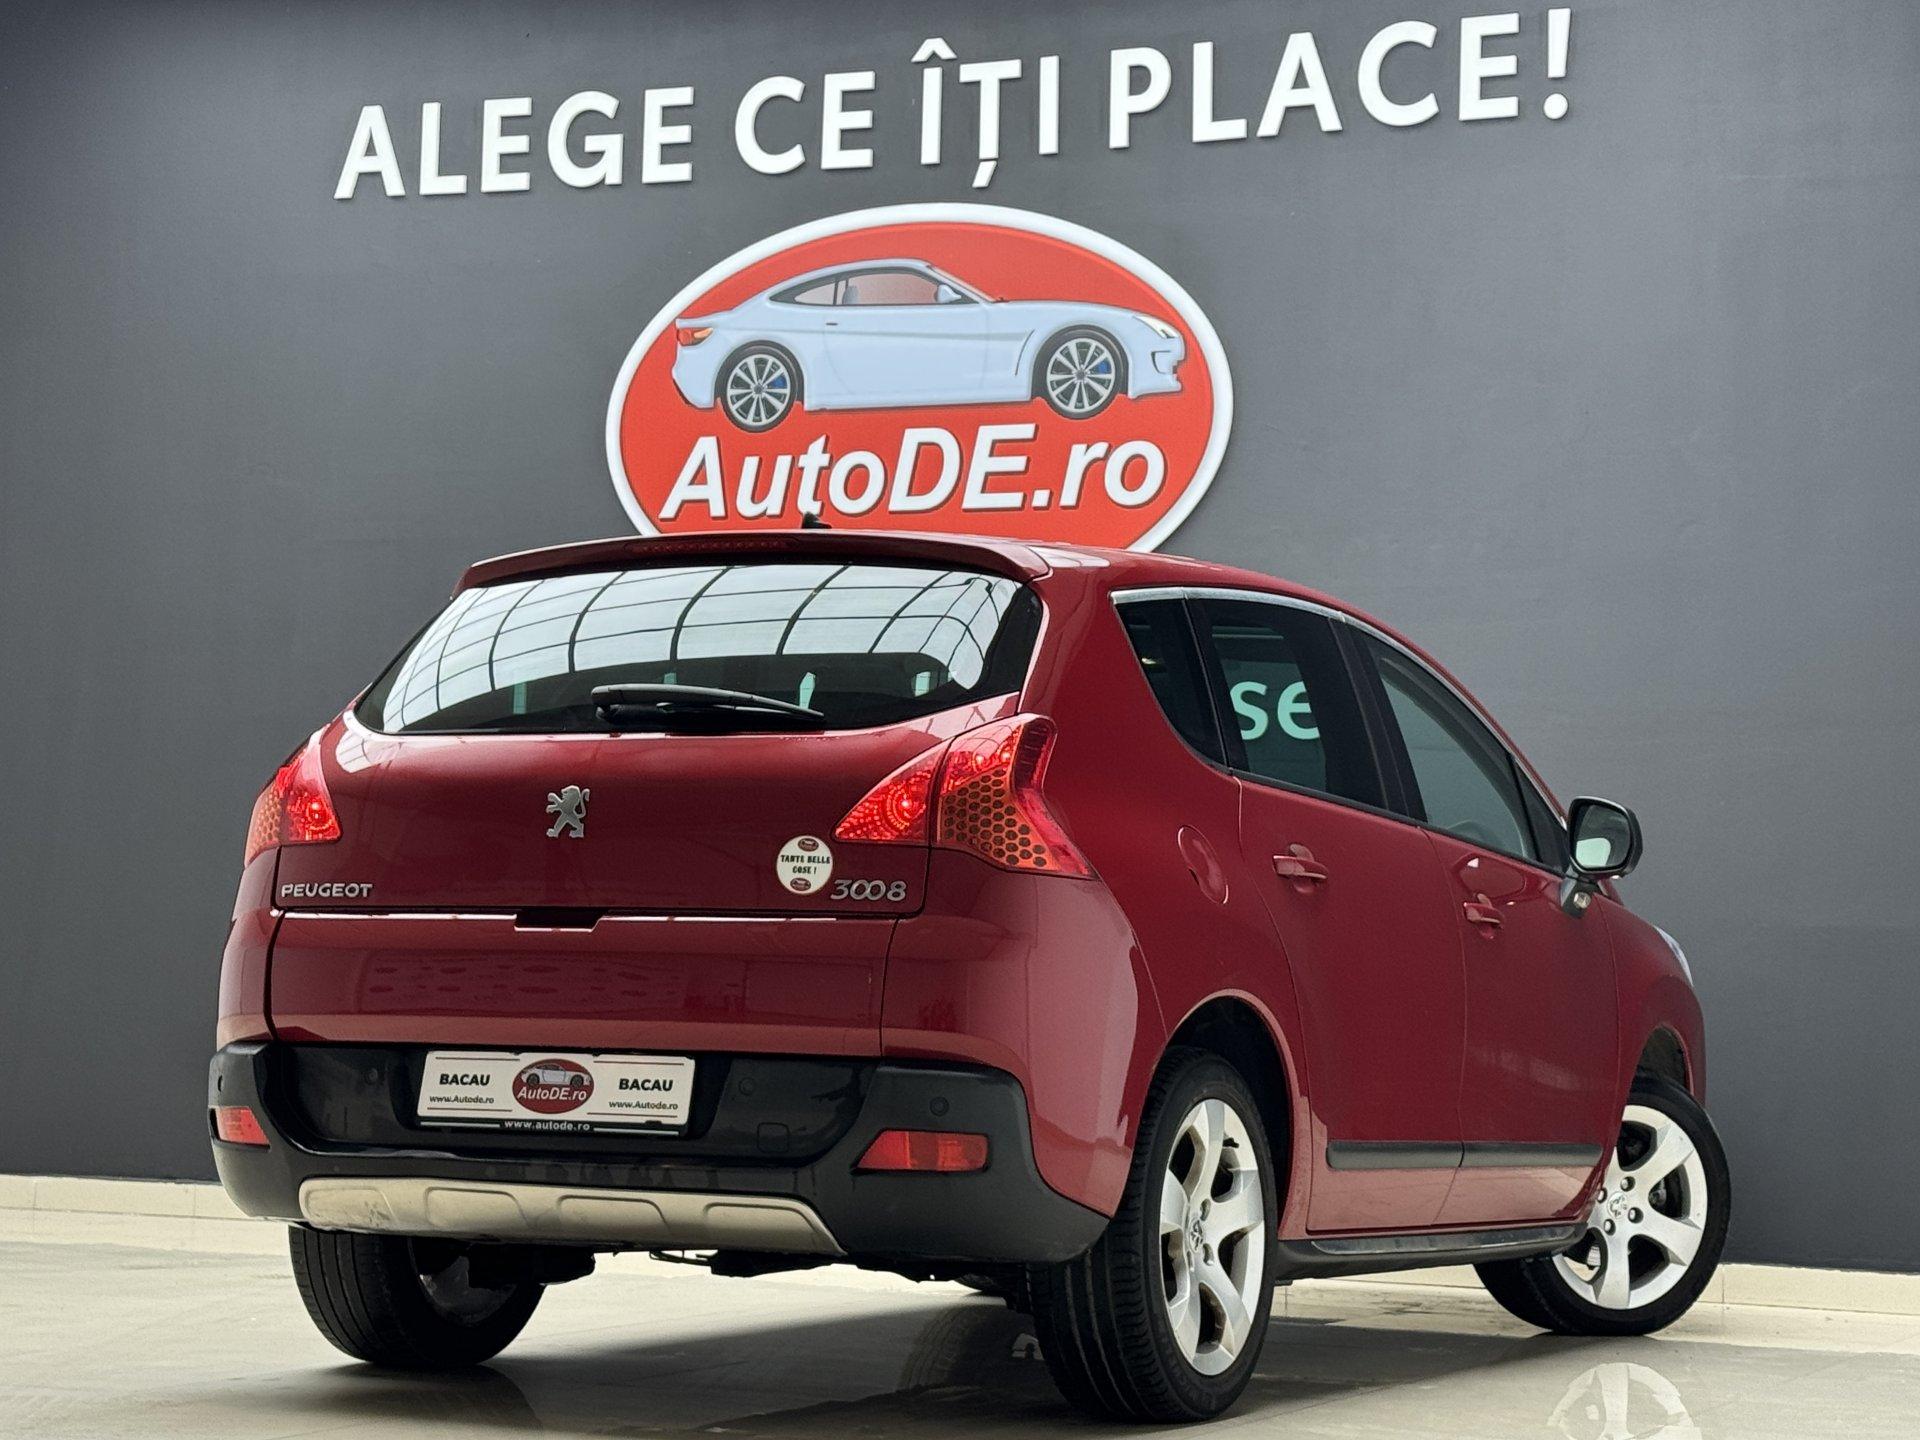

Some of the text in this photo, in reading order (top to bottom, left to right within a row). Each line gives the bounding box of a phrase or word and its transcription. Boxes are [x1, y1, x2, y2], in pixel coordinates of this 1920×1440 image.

[334, 86, 695, 200] ALEGE
[735, 70, 876, 175] CE
[1108, 7, 1572, 150] PLACE!
[658, 422, 1166, 522] AutoDE.ro
[781, 854, 831, 864] TANTE BELLE
[281, 883, 373, 898] PEUGEOT
[830, 879, 907, 901] 3008
[439, 1073, 490, 1086] BACAU
[618, 1078, 673, 1092] BACAU
[429, 1095, 494, 1104] www.Autode.ro
[516, 1085, 587, 1102] AutoDE.ro
[608, 1100, 678, 1111] www.Autode.ro
[504, 1120, 590, 1132] www.autode.ro
